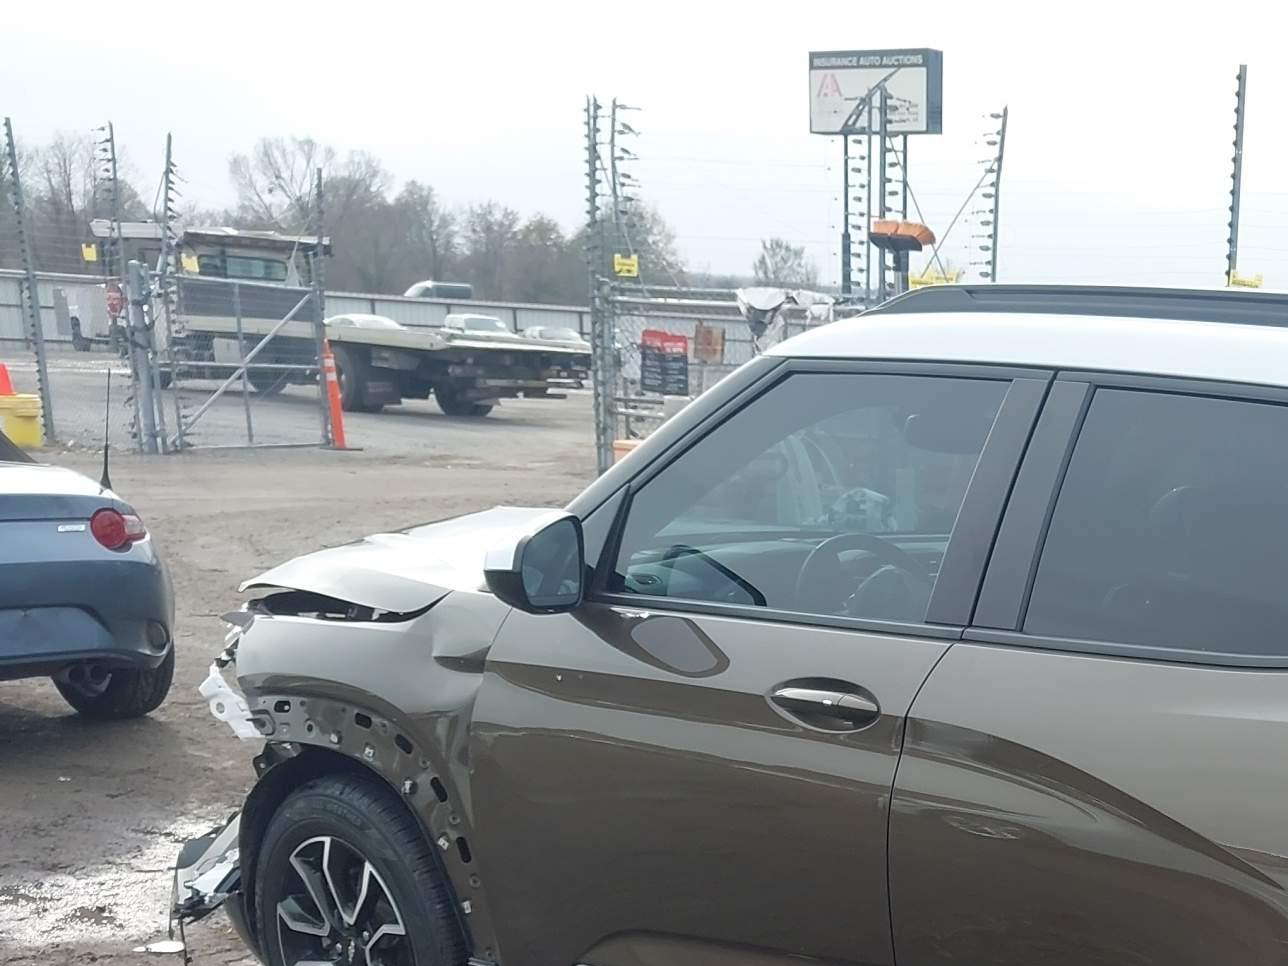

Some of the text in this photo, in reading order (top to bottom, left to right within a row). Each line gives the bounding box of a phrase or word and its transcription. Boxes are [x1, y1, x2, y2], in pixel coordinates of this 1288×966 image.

[813, 54, 923, 67] INSURANCE AUTO AUCTIONS
